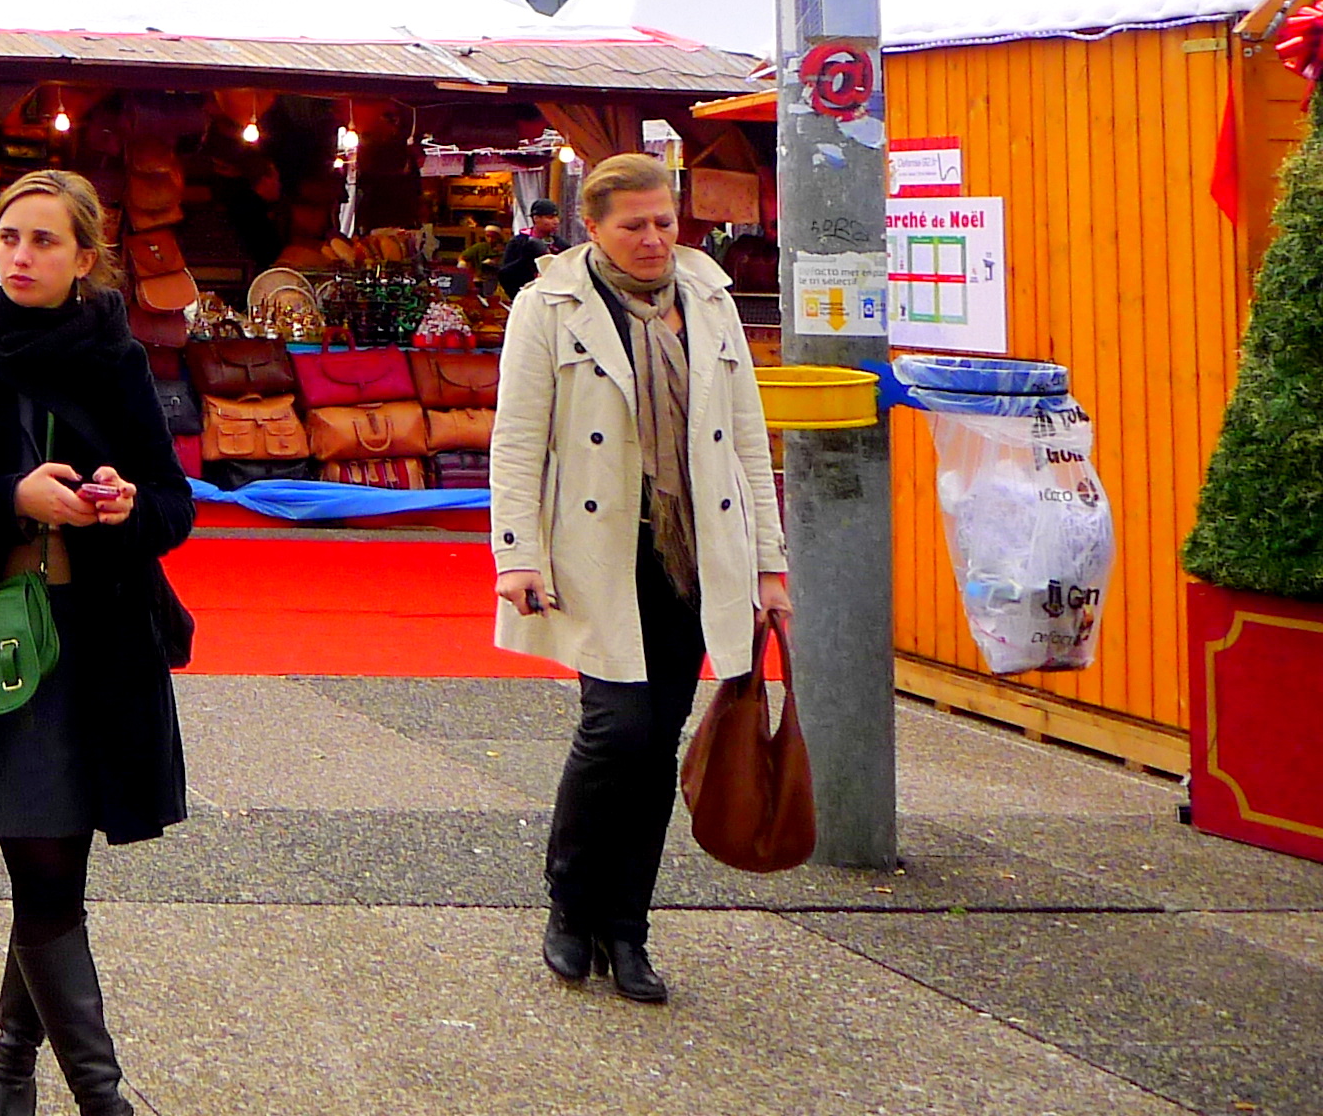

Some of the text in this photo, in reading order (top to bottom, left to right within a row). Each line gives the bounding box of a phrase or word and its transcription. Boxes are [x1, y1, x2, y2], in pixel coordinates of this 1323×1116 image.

[885, 210, 985, 229] arché de Noël
